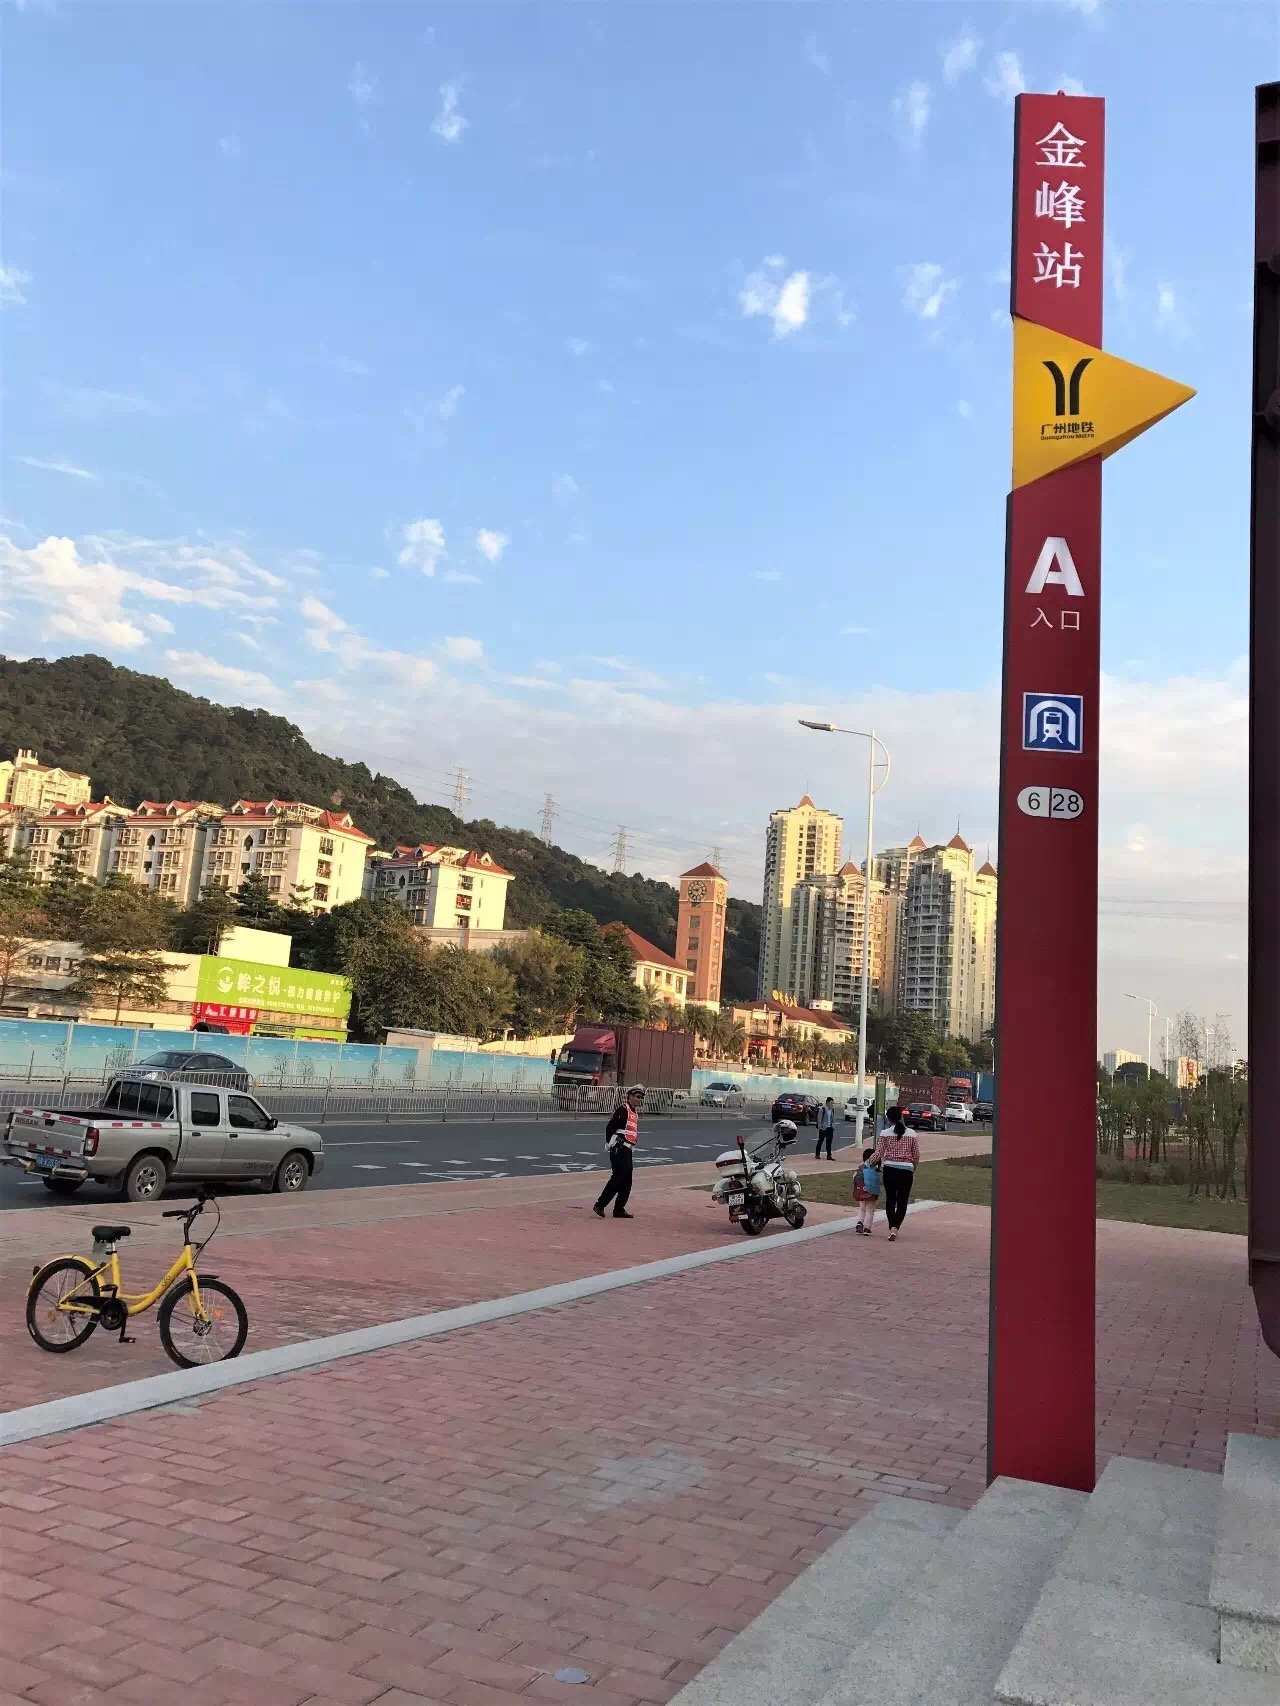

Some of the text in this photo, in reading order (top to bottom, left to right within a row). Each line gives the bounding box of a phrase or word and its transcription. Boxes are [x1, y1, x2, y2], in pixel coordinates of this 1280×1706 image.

[1032, 121, 1088, 289] 金峰站
[1040, 421, 1095, 435] 广州地铁
[1025, 536, 1086, 597] A
[1030, 607, 1081, 631] 入口
[1028, 792, 1080, 812] 6 28
[15, 1117, 39, 1127] NISSAN
